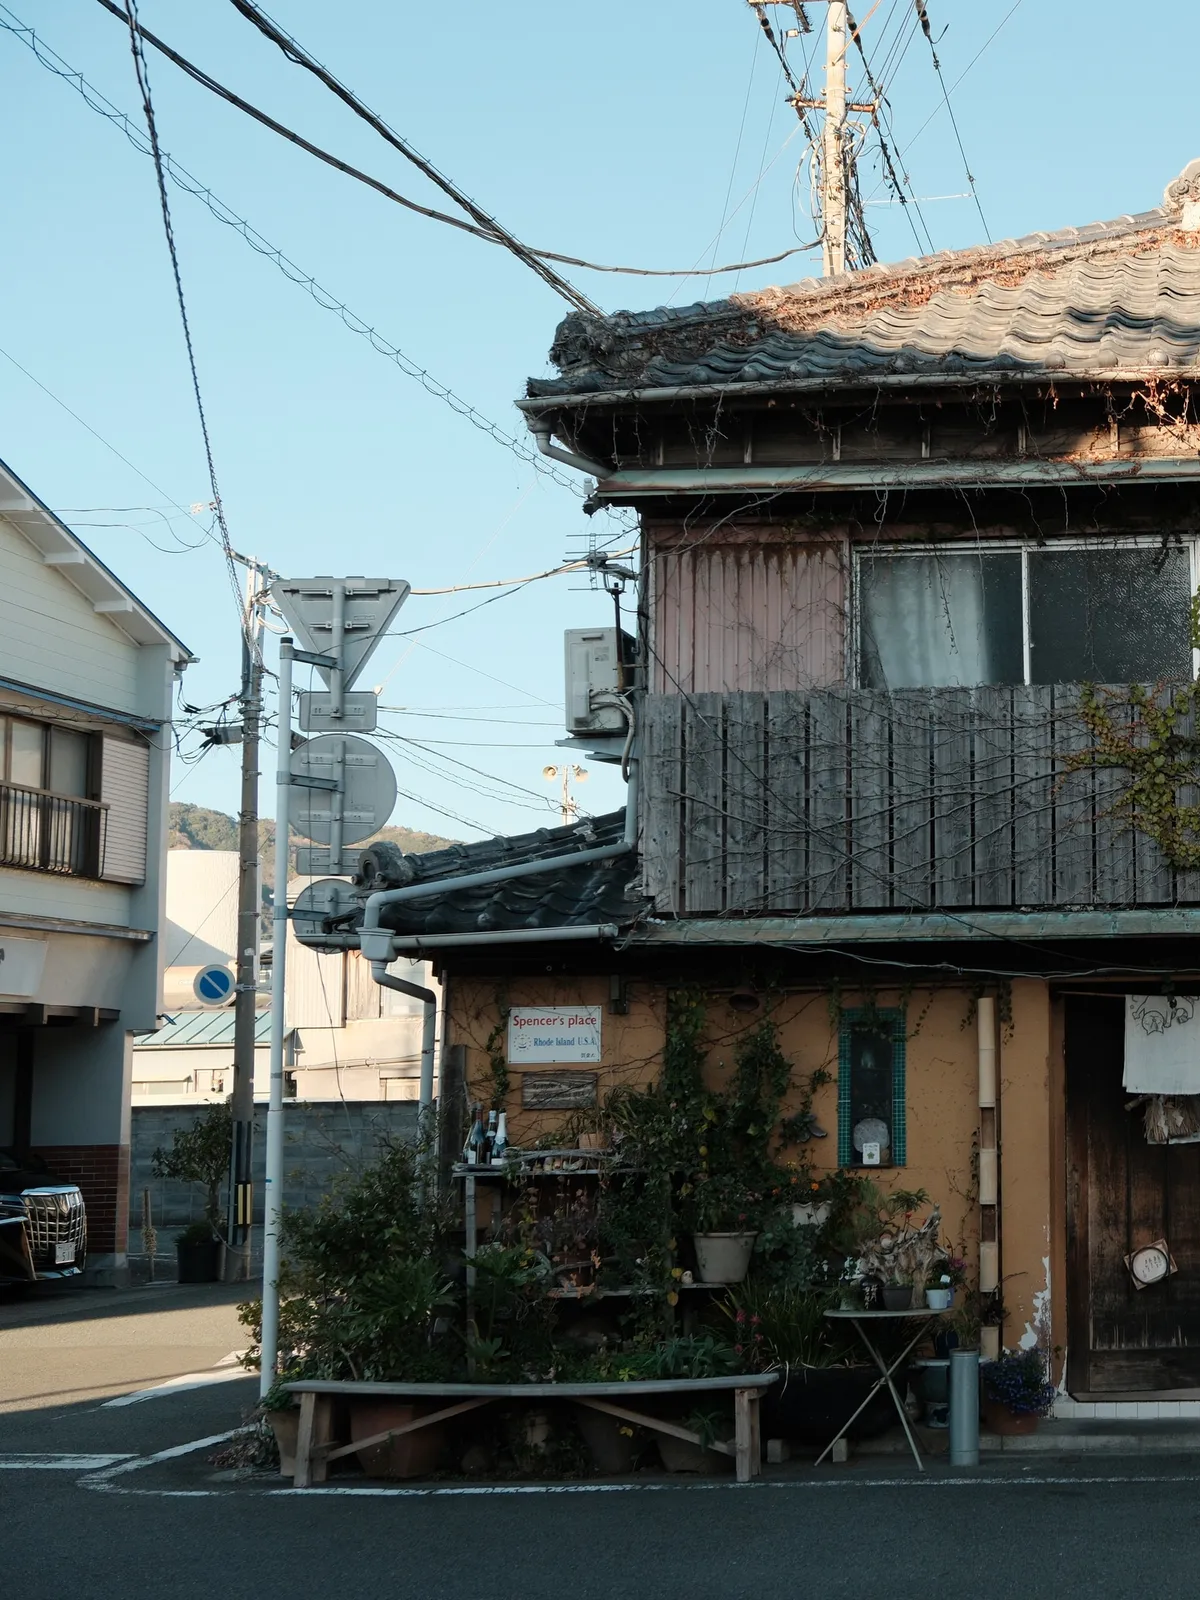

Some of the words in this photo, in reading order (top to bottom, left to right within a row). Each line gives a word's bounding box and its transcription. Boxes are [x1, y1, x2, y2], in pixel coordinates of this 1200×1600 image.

[513, 1015, 564, 1029] Spencer's
[568, 1014, 597, 1028] place
[533, 1037, 554, 1047] Rhode
[555, 1037, 575, 1046] Island
